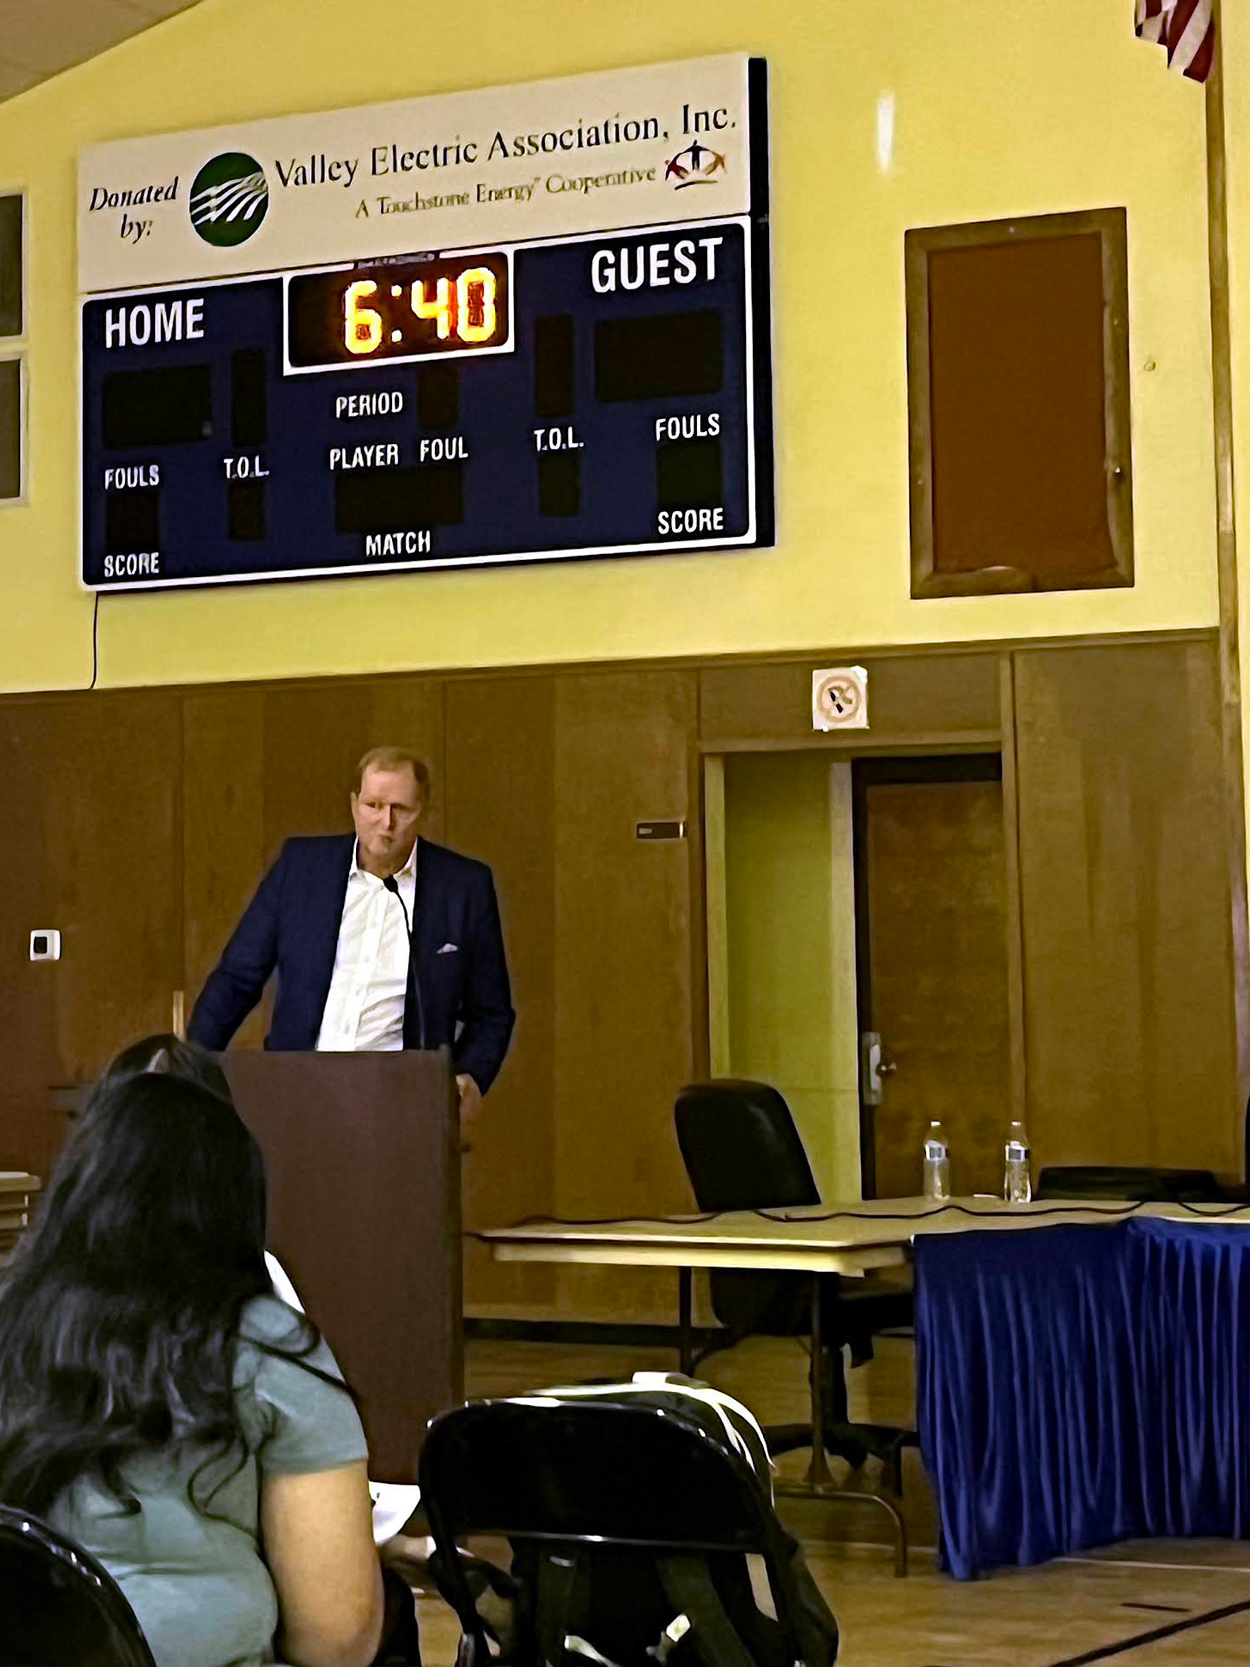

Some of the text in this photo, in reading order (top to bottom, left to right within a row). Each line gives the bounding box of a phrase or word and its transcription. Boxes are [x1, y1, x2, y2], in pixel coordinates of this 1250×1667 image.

[275, 103, 737, 188] Valley Electric Association, Inc.
[89, 176, 179, 211] Donated
[355, 199, 369, 219] A
[377, 191, 469, 216] Touchstone
[546, 167, 657, 194] Cooperative
[120, 214, 152, 244] by:
[591, 237, 723, 294] GUEST
[104, 298, 206, 349] HOME
[343, 267, 498, 355] 6:40
[335, 391, 404, 419] PERIOD
[533, 425, 585, 452] T.O.L.
[655, 413, 721, 441] FOULS
[329, 436, 470, 471] PLAYER FOUL
[104, 464, 160, 490] FOULS
[657, 507, 725, 535] SCORE
[365, 530, 432, 557] MATCH
[104, 551, 160, 578] SCORE
